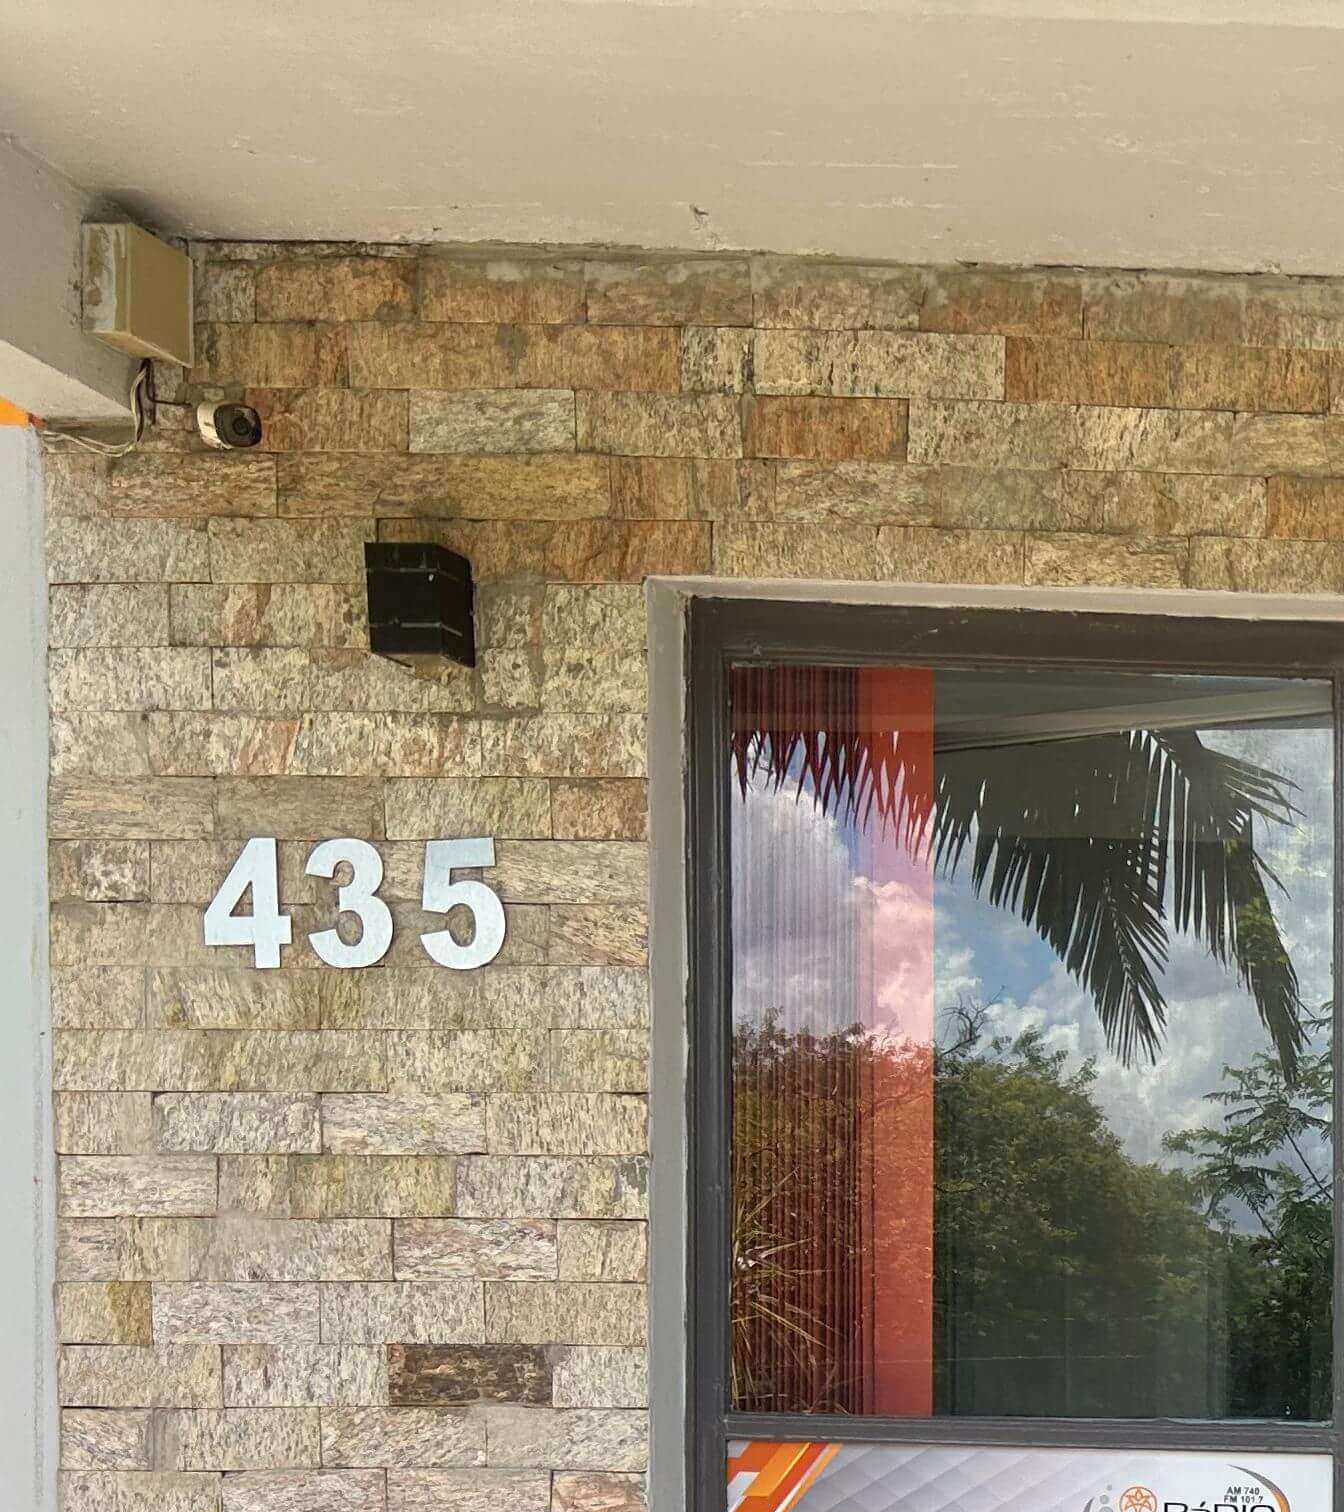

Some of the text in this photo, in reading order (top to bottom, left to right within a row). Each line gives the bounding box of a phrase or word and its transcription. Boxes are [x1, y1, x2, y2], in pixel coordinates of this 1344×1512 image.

[203, 837, 506, 970] 435
[1227, 1486, 1260, 1495] AM 740
[1224, 1495, 1238, 1503] FM
